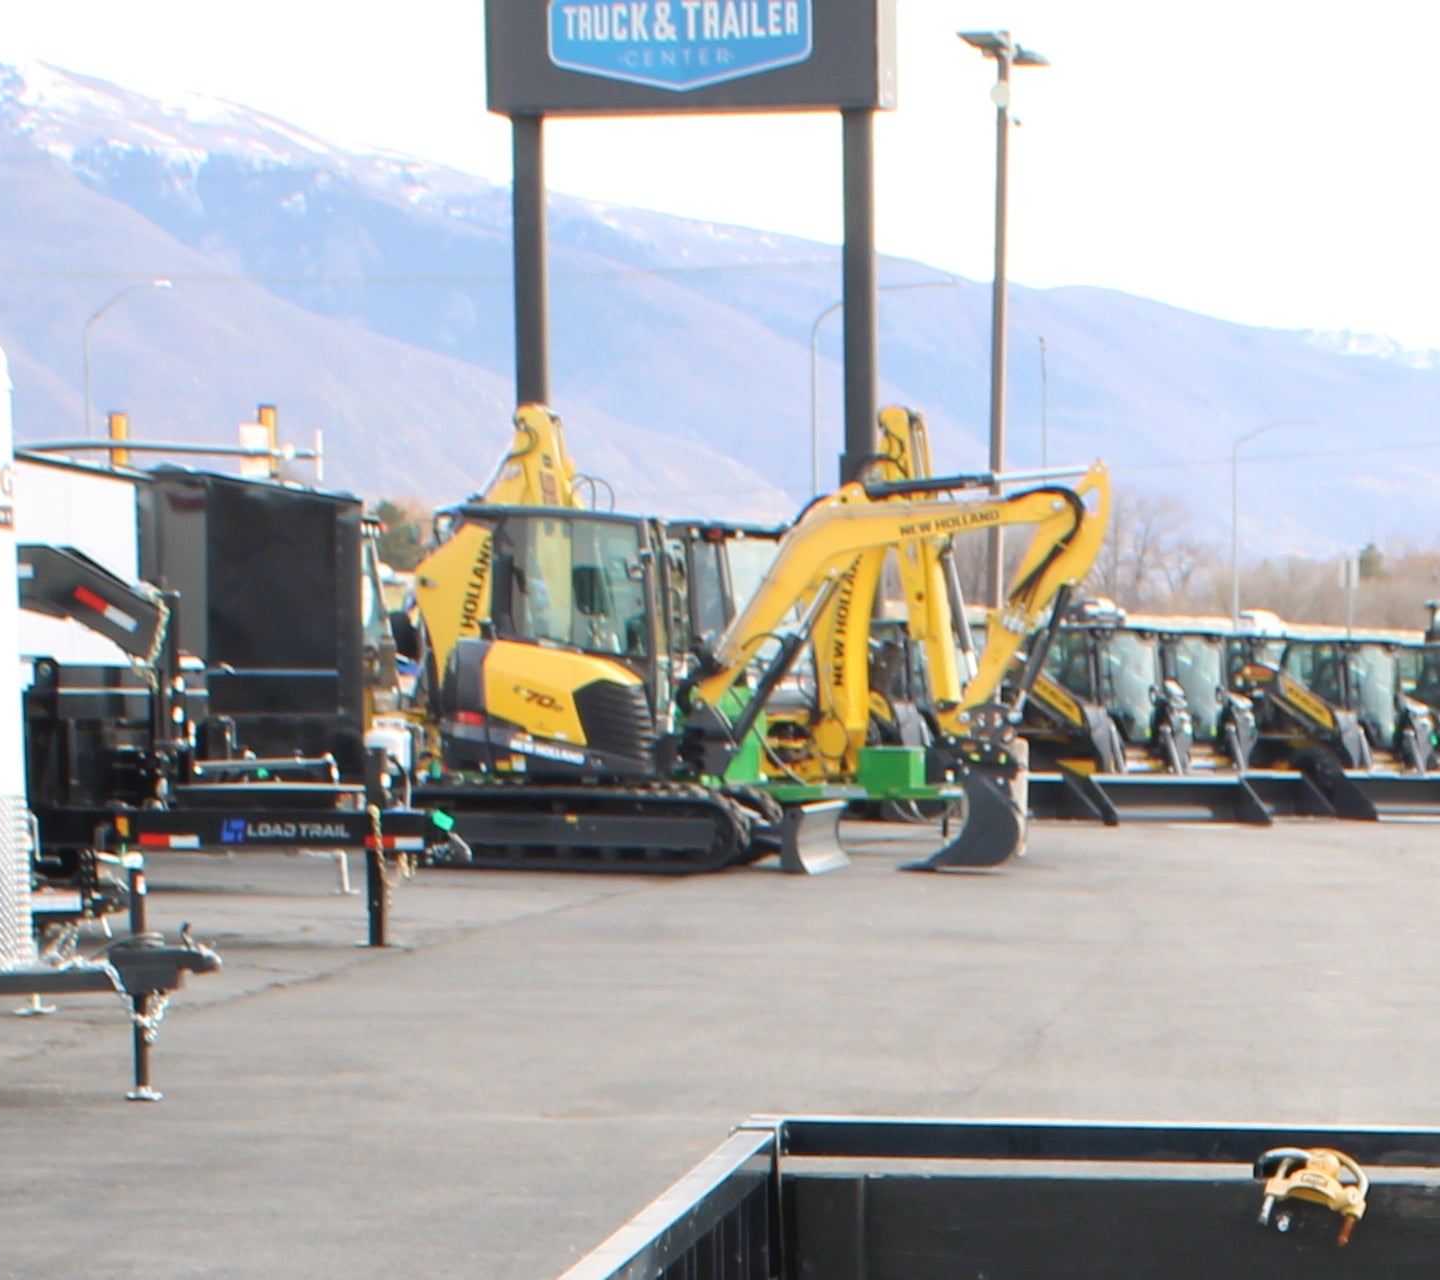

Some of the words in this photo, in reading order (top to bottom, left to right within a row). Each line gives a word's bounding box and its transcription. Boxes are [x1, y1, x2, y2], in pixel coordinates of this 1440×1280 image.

[562, 2, 650, 41] TRUCK
[653, 0, 678, 41] &
[680, 0, 800, 41] TRAILER
[624, 47, 730, 67] CENTER
[900, 521, 931, 535] NEW
[935, 508, 1000, 531] HOLLAND
[834, 552, 863, 635] HOLLAN
[832, 639, 846, 687] NEW
[246, 821, 298, 838] LOAD
[299, 821, 351, 839] TRAIL
